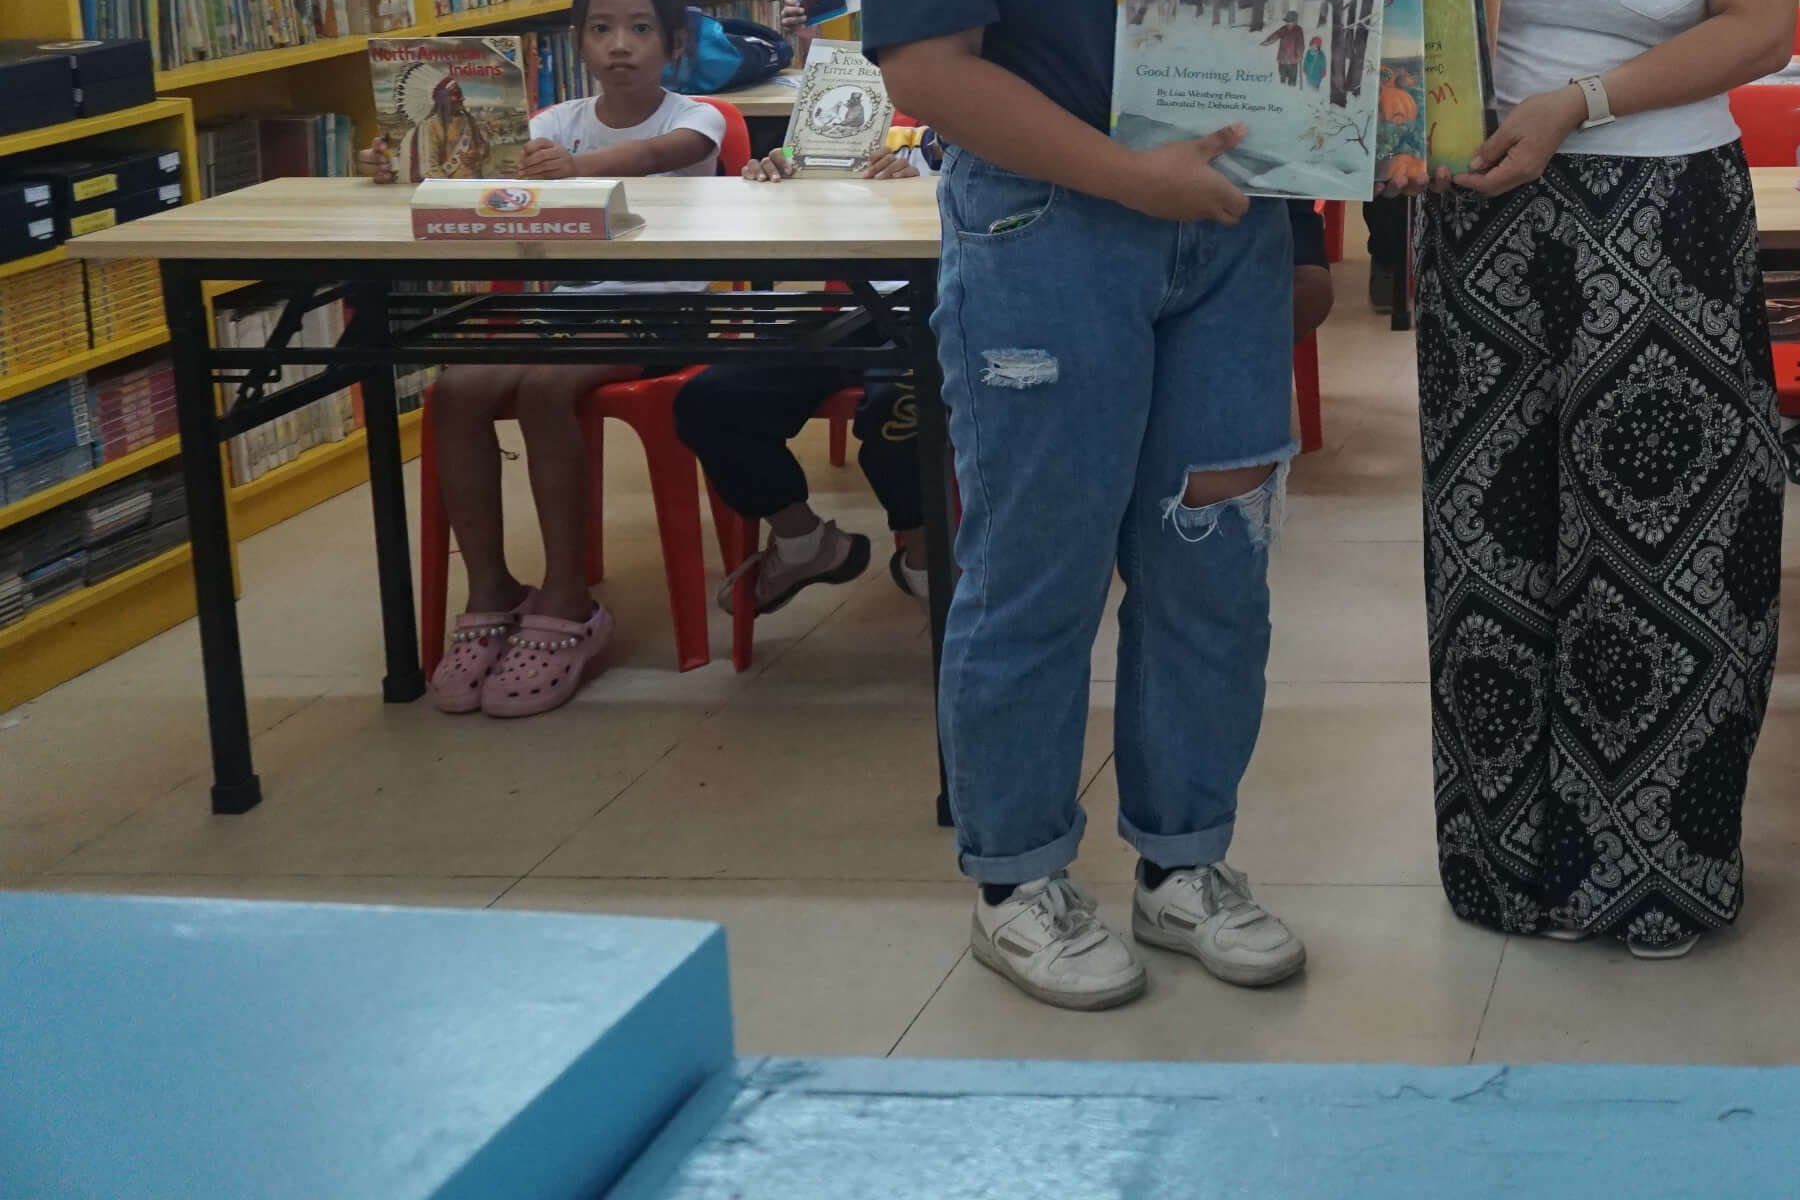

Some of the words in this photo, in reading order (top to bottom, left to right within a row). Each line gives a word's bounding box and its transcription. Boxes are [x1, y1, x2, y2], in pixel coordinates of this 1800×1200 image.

[369, 47, 413, 62] North
[415, 46, 488, 62] American
[448, 63, 504, 77] Indians
[1136, 64, 1170, 78] Good
[1173, 66, 1231, 83] Morning,
[1235, 68, 1273, 82] River!
[1157, 88, 1167, 97] By
[1156, 99, 1195, 108] Illustrated
[1196, 100, 1206, 109] by
[426, 223, 487, 234] KEEP
[493, 222, 592, 234] SILENCE
